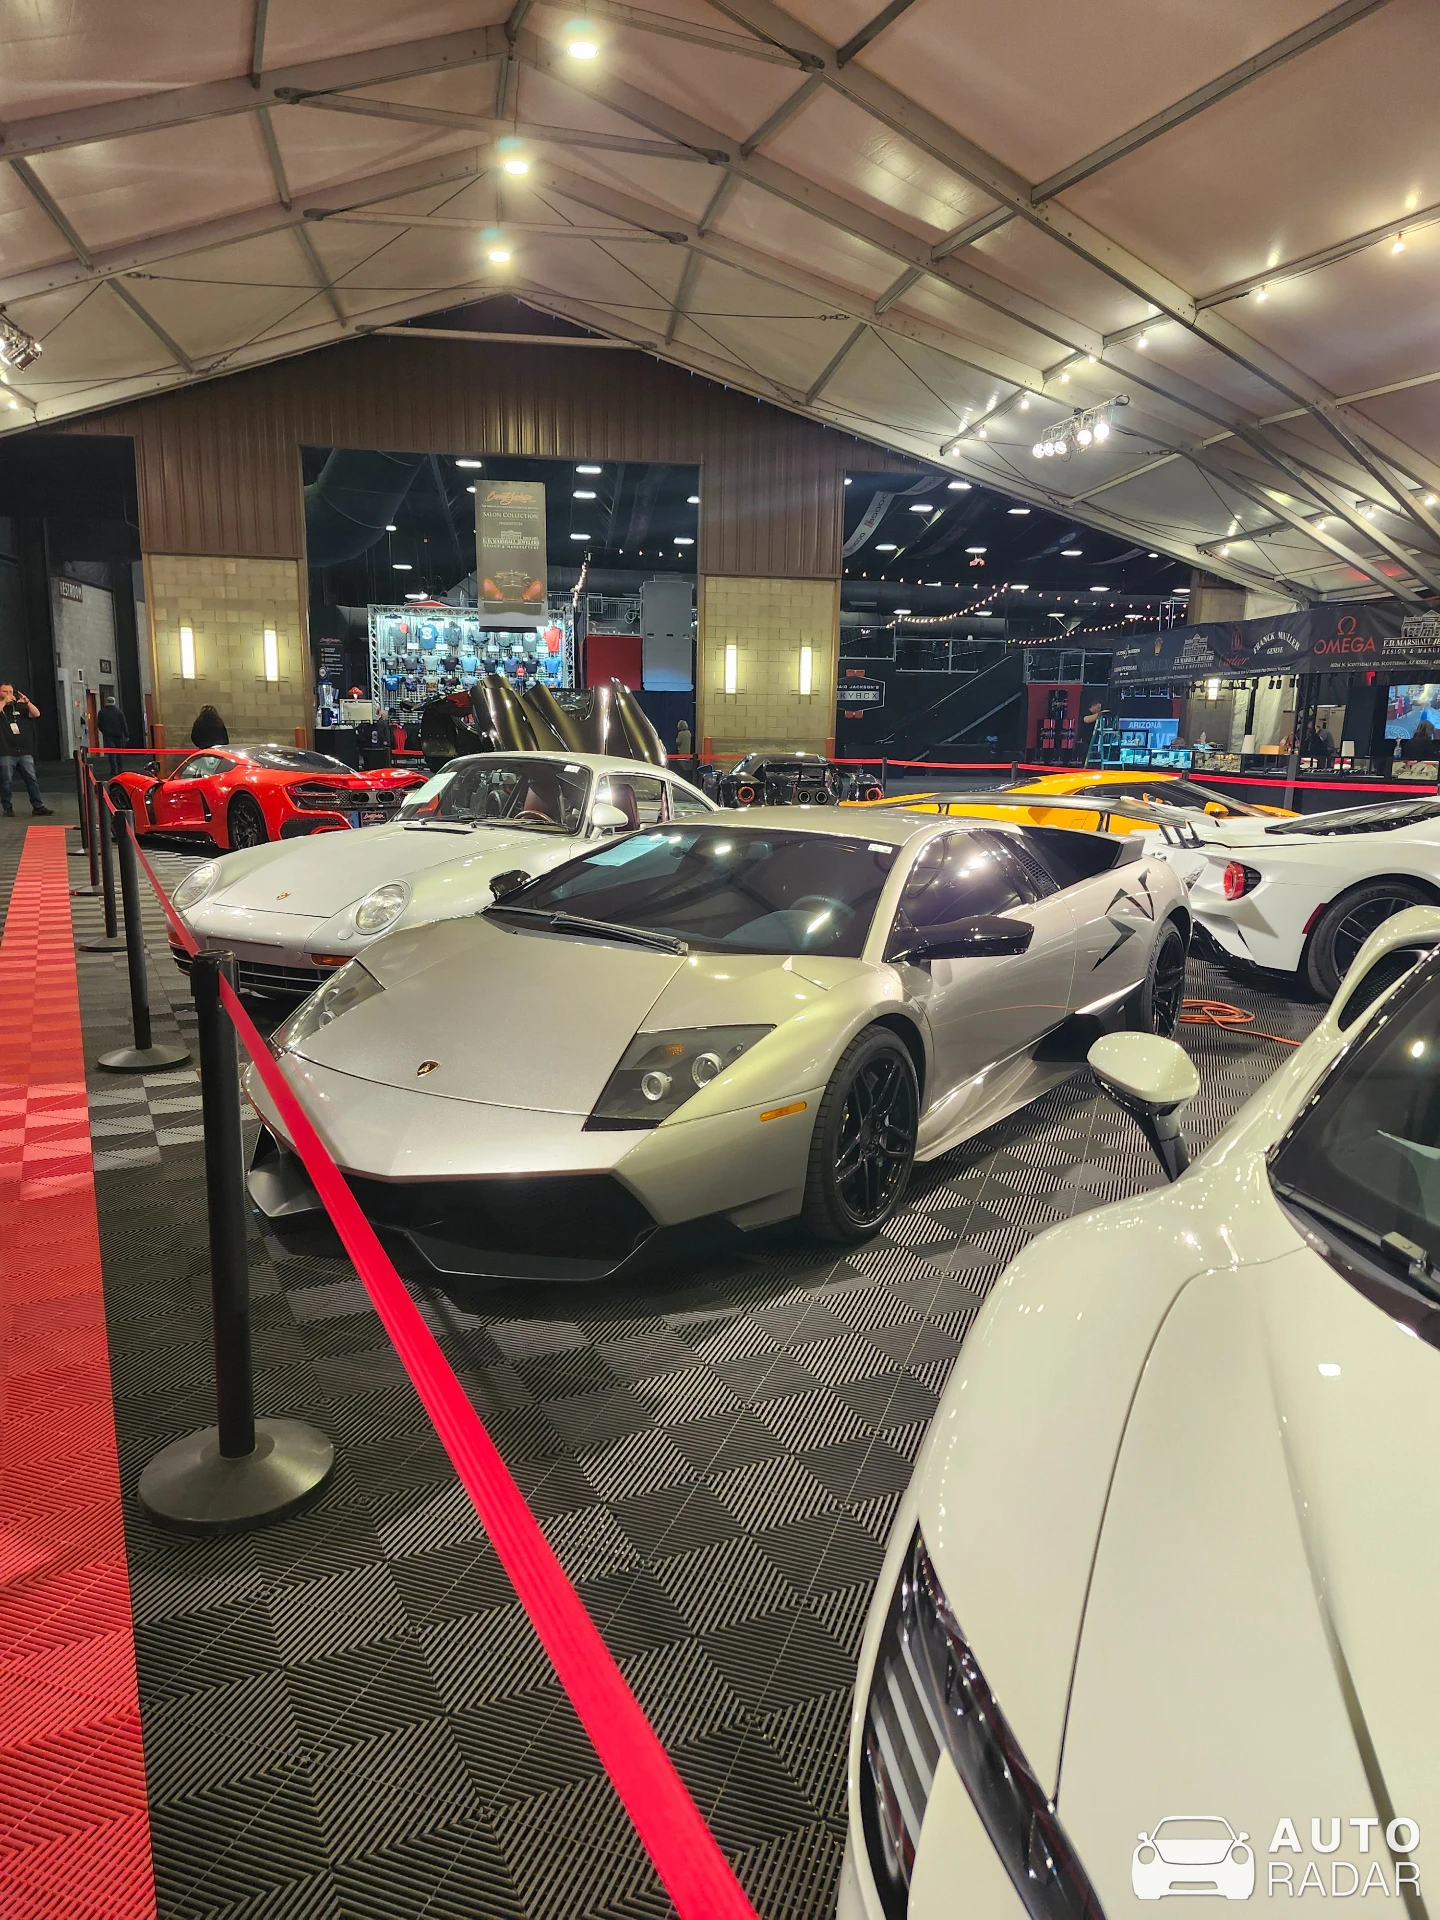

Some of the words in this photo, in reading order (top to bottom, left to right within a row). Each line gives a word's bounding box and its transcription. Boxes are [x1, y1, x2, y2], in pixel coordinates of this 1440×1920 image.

[1253, 631, 1276, 655] FRANCK
[1278, 631, 1300, 652] MULLER
[1313, 636, 1376, 655] OMEGA
[1396, 638, 1432, 647] MARSHALL
[1142, 659, 1169, 672] ROLEX
[837, 692, 878, 700] KYBOX
[1128, 721, 1162, 729] ARIZONA
